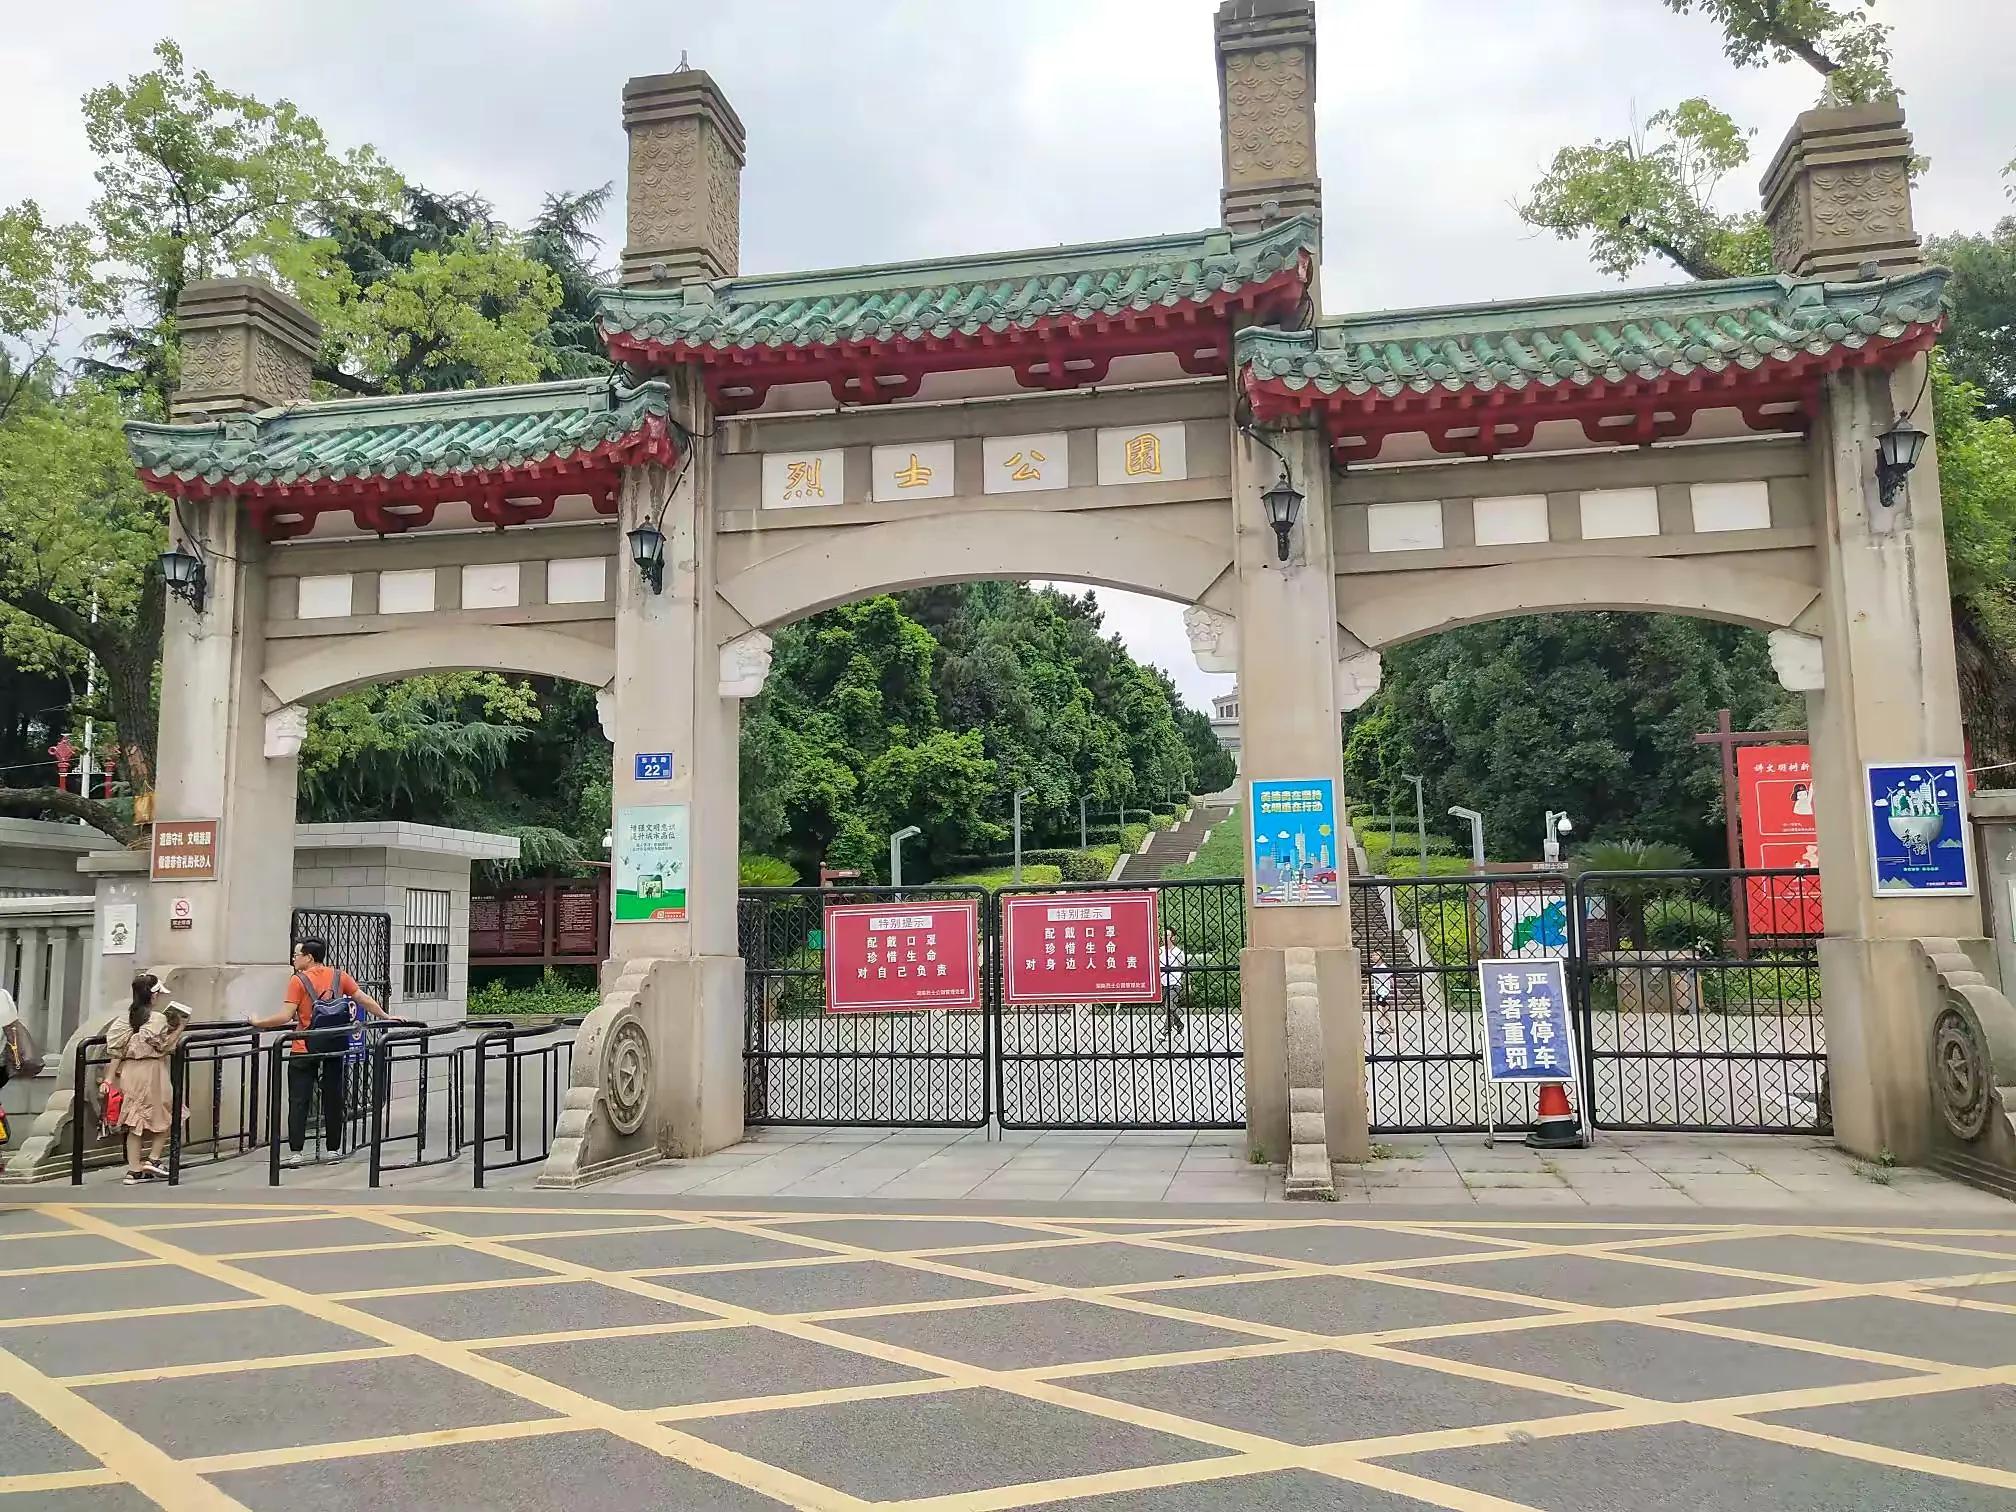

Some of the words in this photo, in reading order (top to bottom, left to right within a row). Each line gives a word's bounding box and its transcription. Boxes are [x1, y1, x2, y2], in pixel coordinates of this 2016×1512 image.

[644, 764, 660, 776] 22
[1056, 908, 1103, 920] 特别提示
[878, 917, 925, 929] 特别提示
[1044, 926, 1116, 940] 配戴口罩
[866, 934, 937, 949] 配戴口罩
[1045, 941, 1117, 954] 珍惜生命
[867, 950, 937, 963] 珍惜生命
[1025, 956, 1137, 971] 对身边人负责
[857, 964, 947, 979] 对自己负责
[1497, 973, 1528, 1070] 违者重罚
[1526, 973, 1557, 1069] 严禁停车
